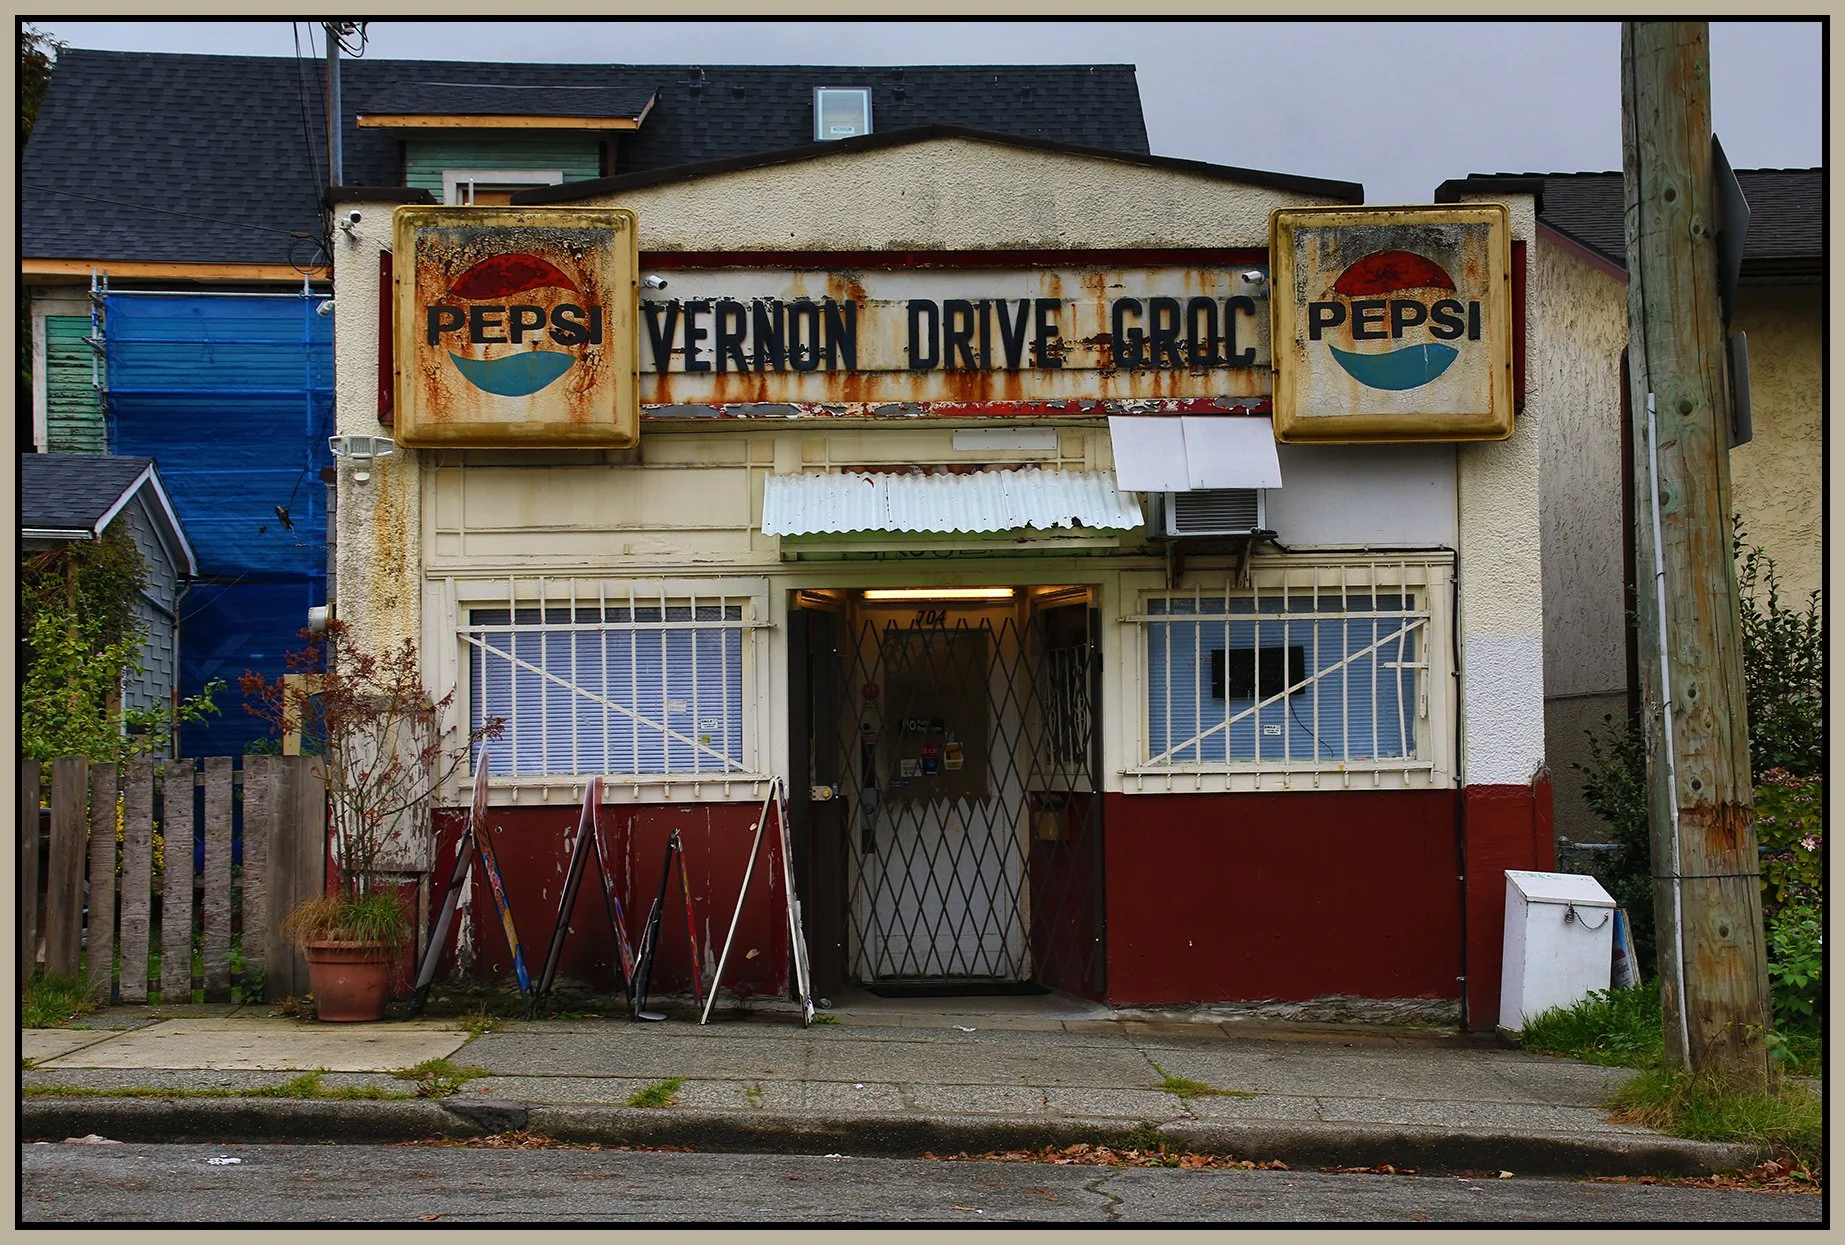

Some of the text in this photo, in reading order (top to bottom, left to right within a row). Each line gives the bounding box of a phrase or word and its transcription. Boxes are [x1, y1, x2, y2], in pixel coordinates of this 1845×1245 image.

[426, 303, 601, 346] PEPSI
[645, 295, 1256, 373] VERNON DRIVE GROC
[1308, 299, 1481, 341] PEPSI
[916, 609, 946, 625] 704
